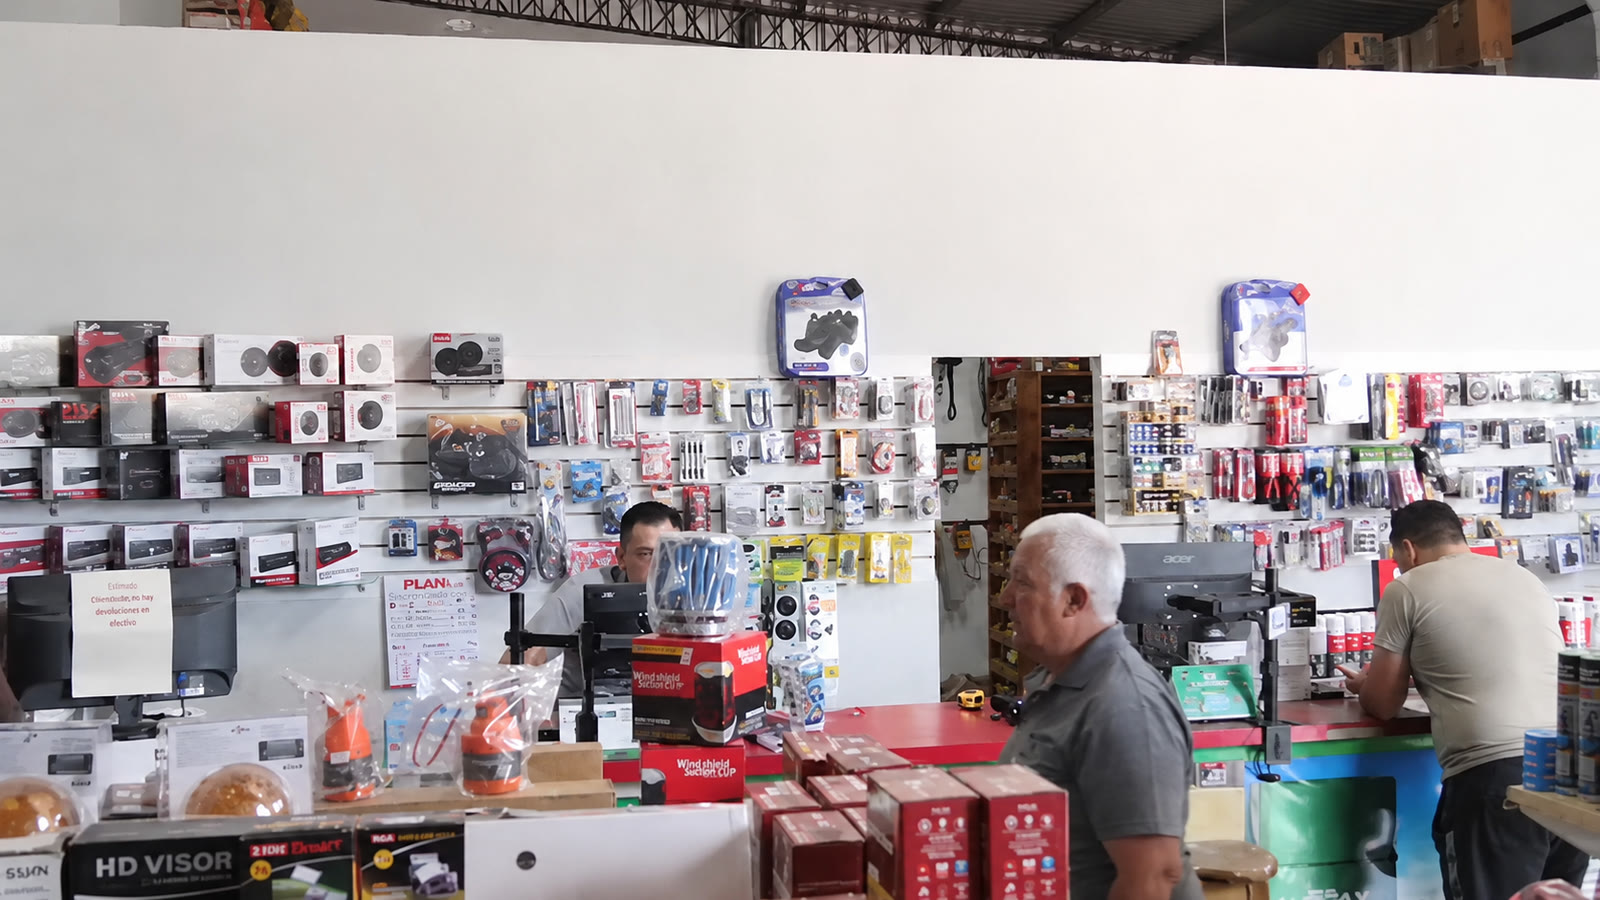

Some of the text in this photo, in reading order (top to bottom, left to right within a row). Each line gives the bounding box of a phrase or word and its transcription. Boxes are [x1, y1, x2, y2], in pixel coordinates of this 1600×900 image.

[1163, 555, 1196, 564] acer
[107, 582, 138, 591] Estimado
[131, 594, 141, 602] no
[141, 593, 154, 602] hay
[140, 606, 150, 614] en
[109, 618, 137, 628] efectivo
[95, 851, 233, 878] HD VISOR
